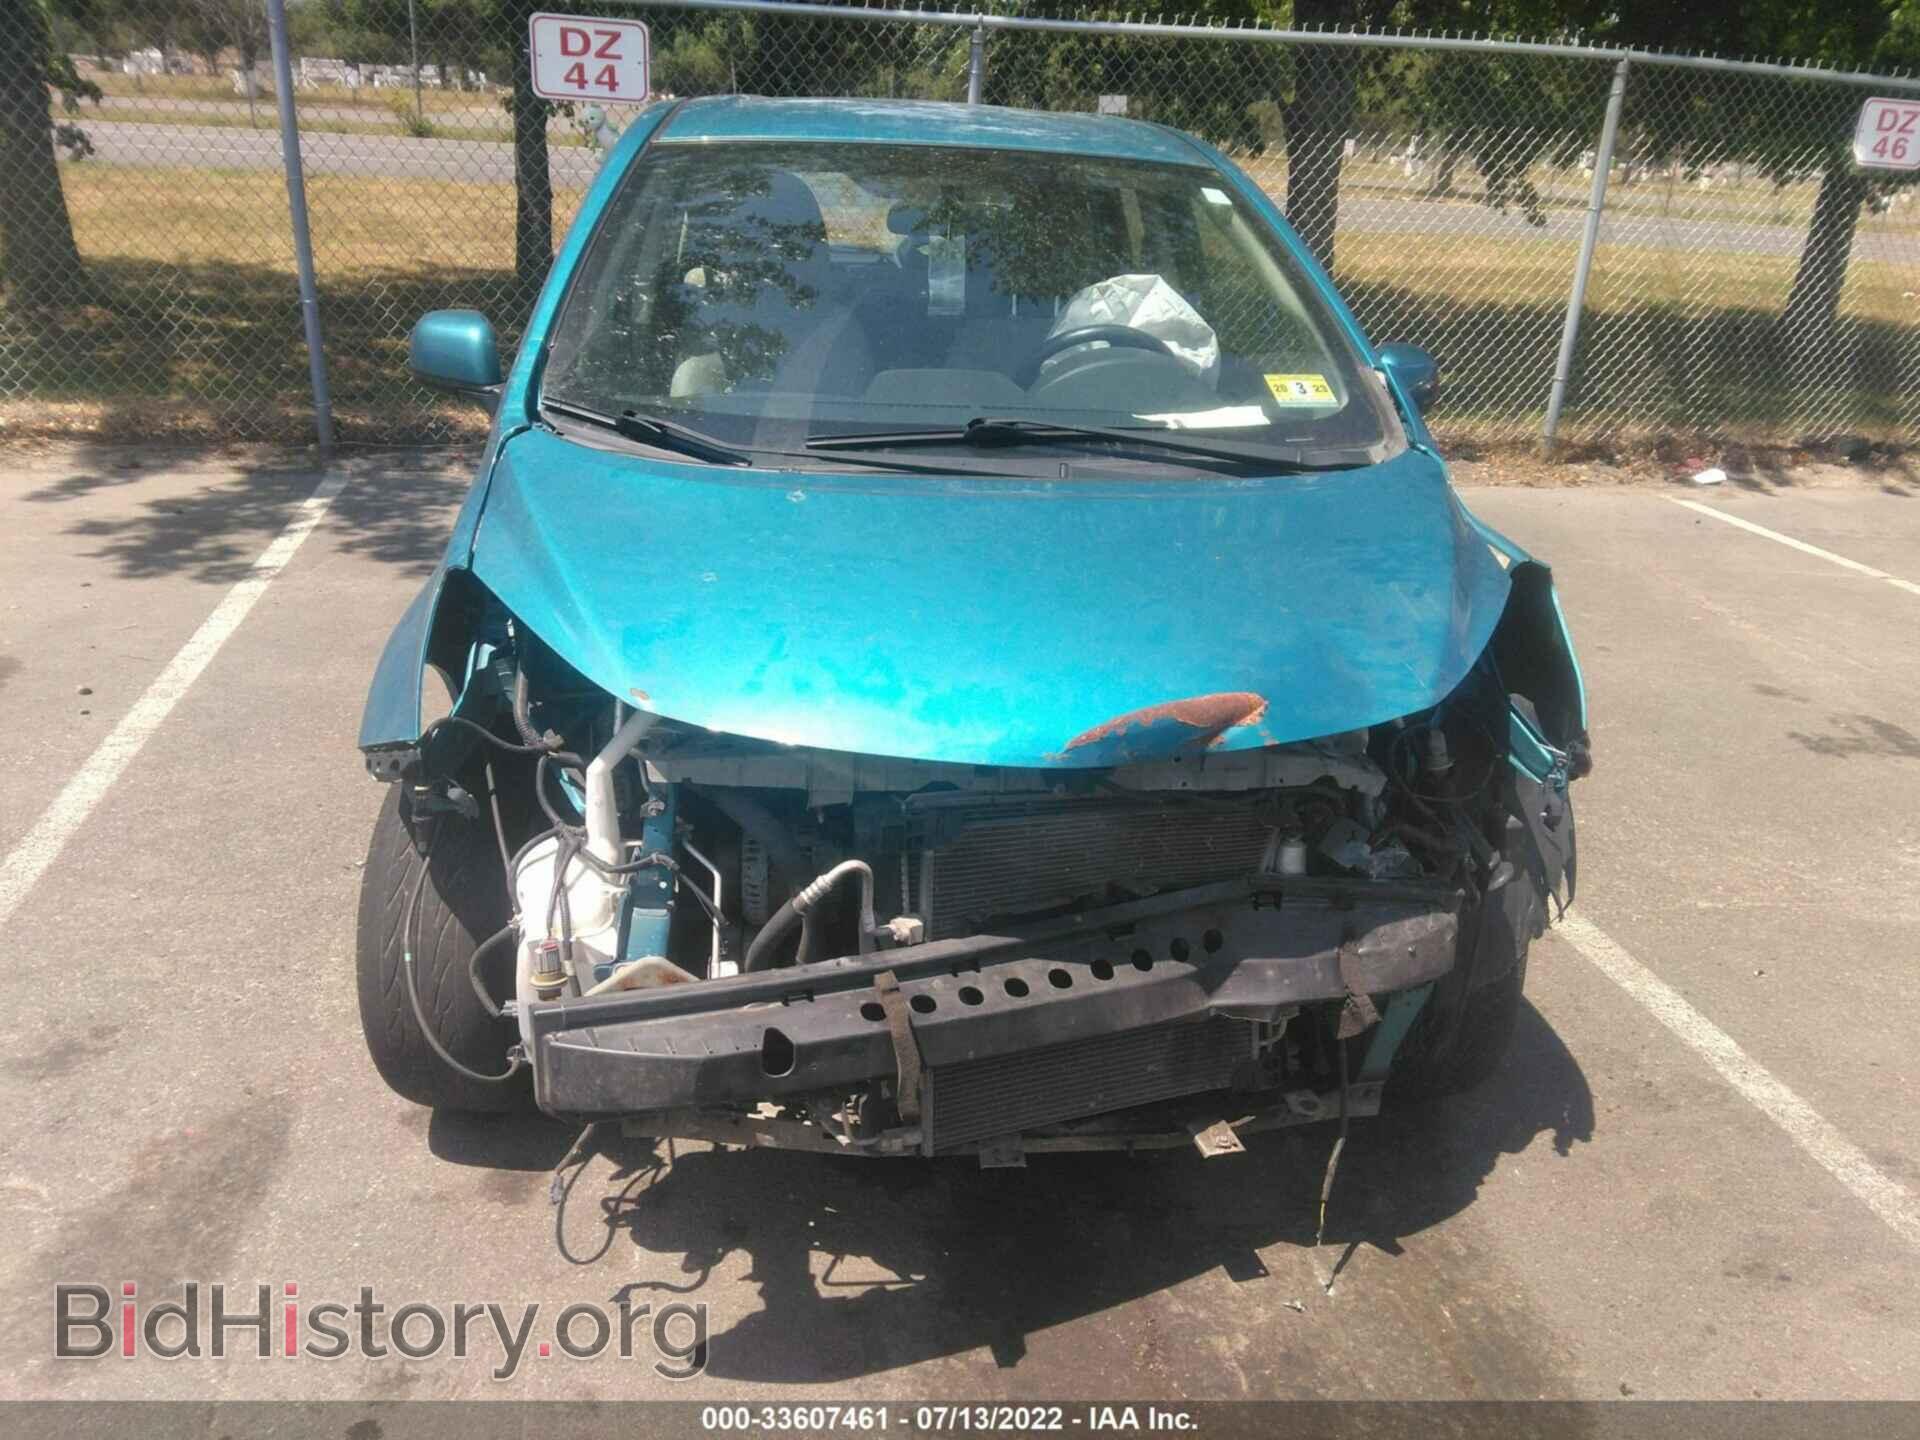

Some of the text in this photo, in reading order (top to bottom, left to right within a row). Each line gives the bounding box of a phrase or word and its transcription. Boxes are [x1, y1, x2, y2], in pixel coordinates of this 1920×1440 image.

[559, 26, 623, 61] DZ
[563, 62, 620, 92] 44
[1876, 108, 1920, 134] DZ
[1872, 135, 1910, 160] 46
[1294, 381, 1308, 395] 3
